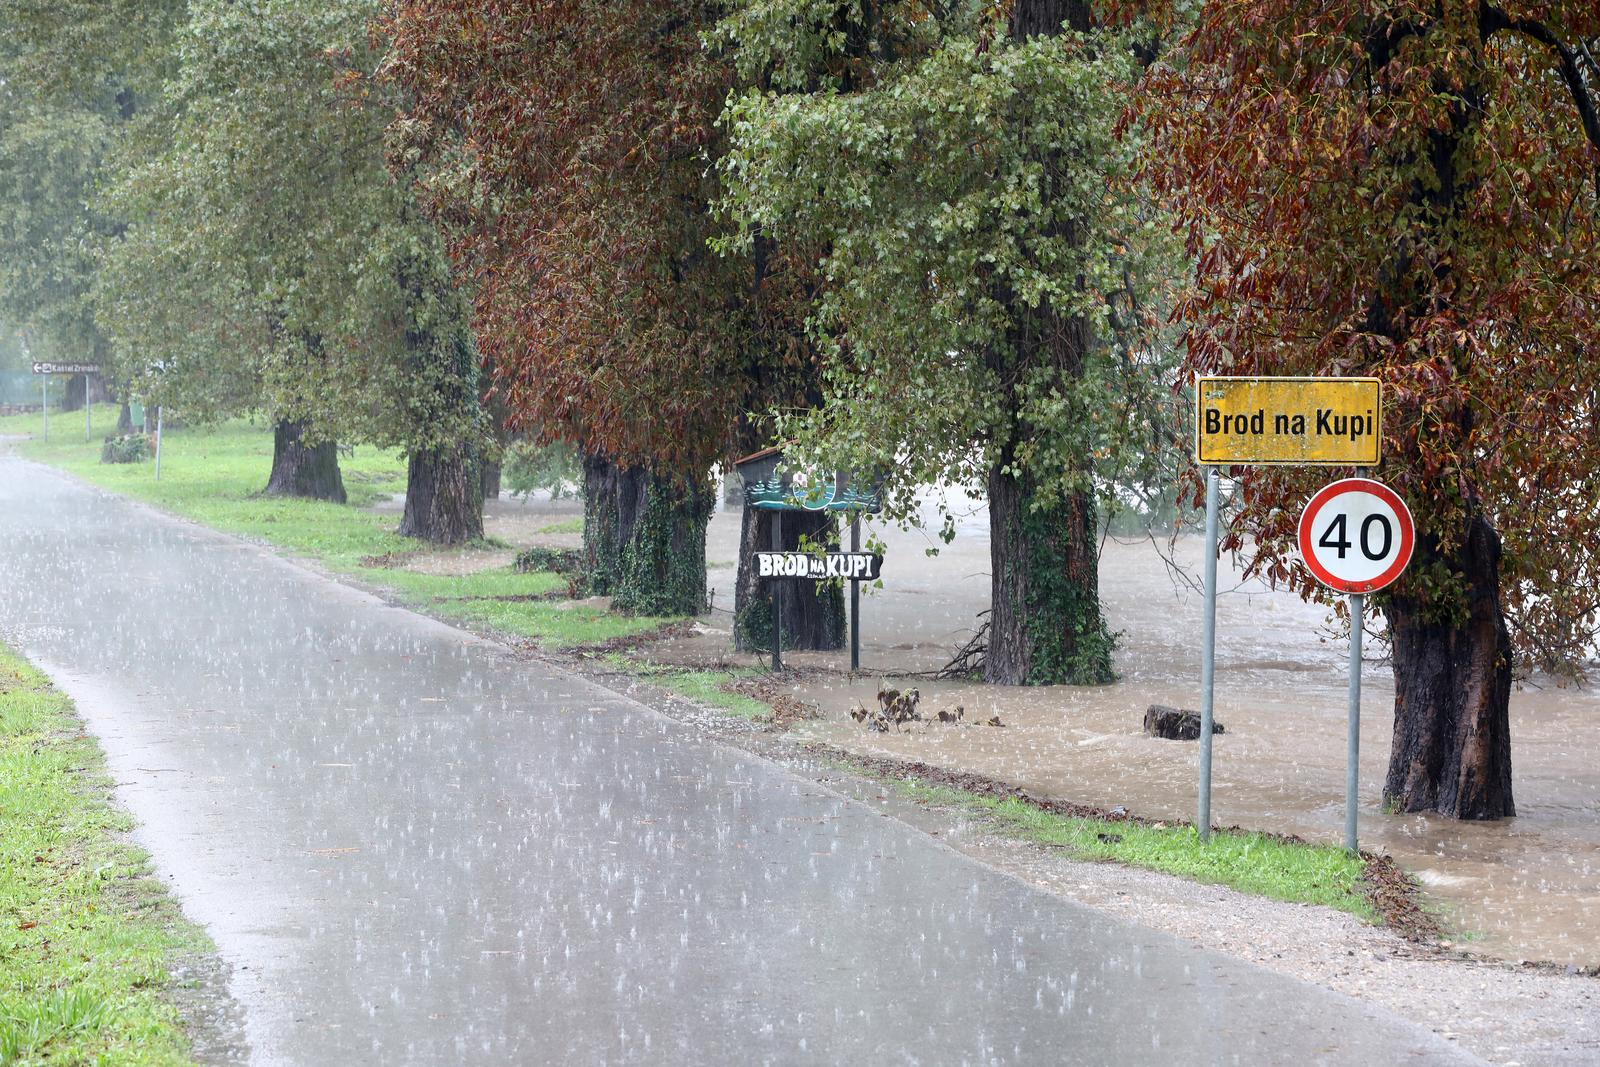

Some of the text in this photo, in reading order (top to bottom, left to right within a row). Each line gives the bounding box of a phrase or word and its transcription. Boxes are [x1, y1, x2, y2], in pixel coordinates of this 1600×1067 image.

[1205, 408, 1373, 442] Brod na Kupi
[1318, 513, 1393, 562] 40
[758, 553, 874, 578] BROD NA KUPI
